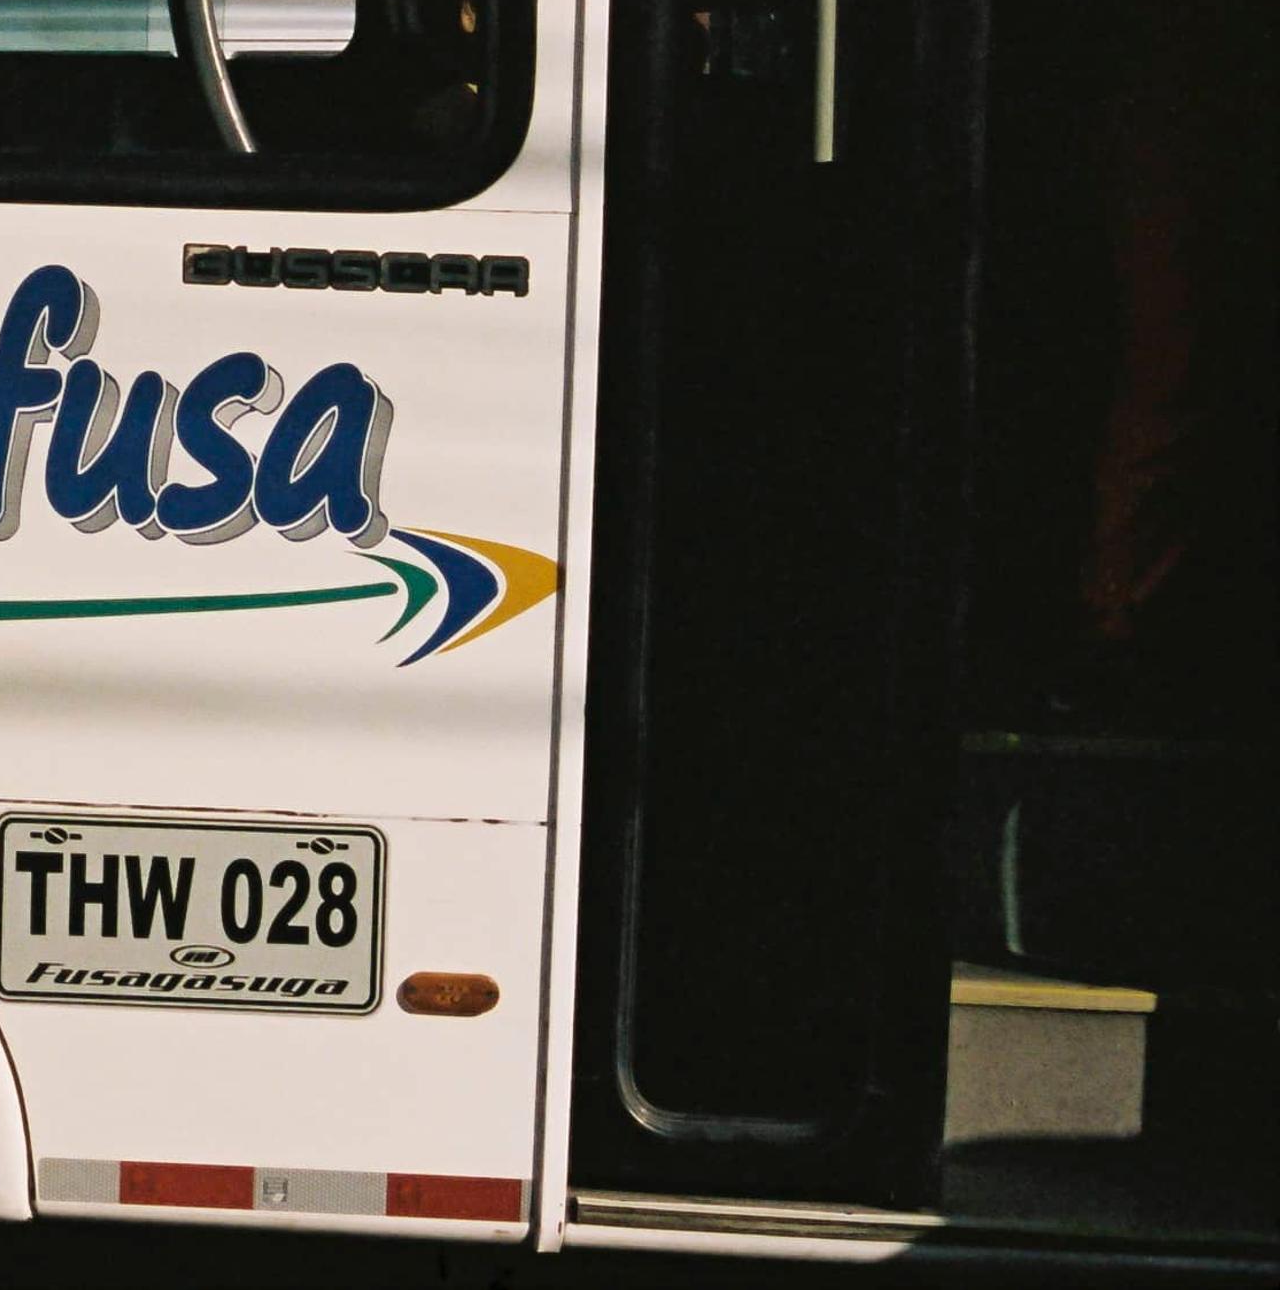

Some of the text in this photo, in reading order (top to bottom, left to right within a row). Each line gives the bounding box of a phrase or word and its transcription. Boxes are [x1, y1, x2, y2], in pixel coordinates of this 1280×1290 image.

[183, 243, 530, 297] BUSSCAR
[15, 851, 358, 947] THW 028
[26, 962, 349, 996] Fusagasuga
